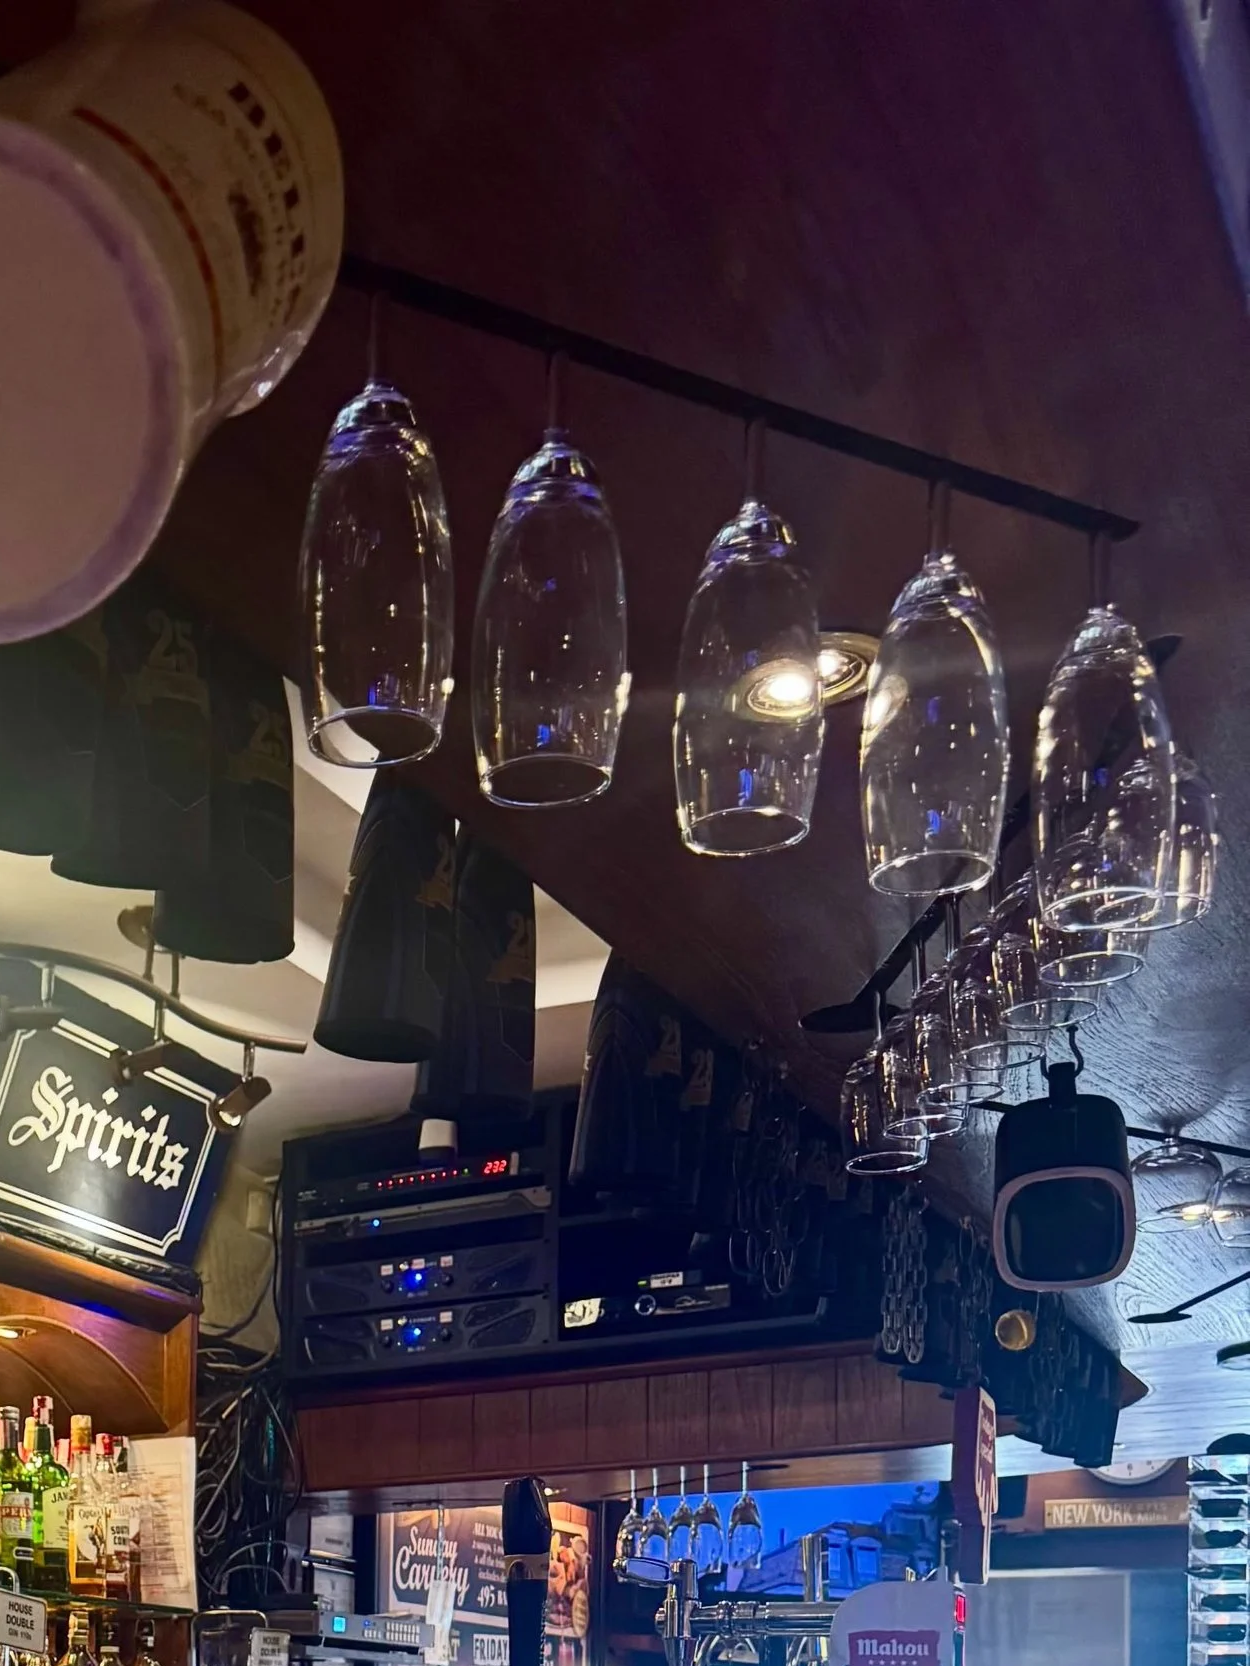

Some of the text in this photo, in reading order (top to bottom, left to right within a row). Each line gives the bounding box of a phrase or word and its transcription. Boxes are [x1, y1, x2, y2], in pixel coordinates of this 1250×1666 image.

[8, 1066, 190, 1192] Spirits
[483, 1159, 507, 1176] 232
[1053, 1504, 1091, 1525] NEW
[1092, 1503, 1131, 1523] YORK
[478, 1584, 496, 1608] 495
[8, 1601, 33, 1617] HOUSE
[6, 1614, 35, 1630] DOUBLE
[857, 1639, 929, 1656] Mahou
